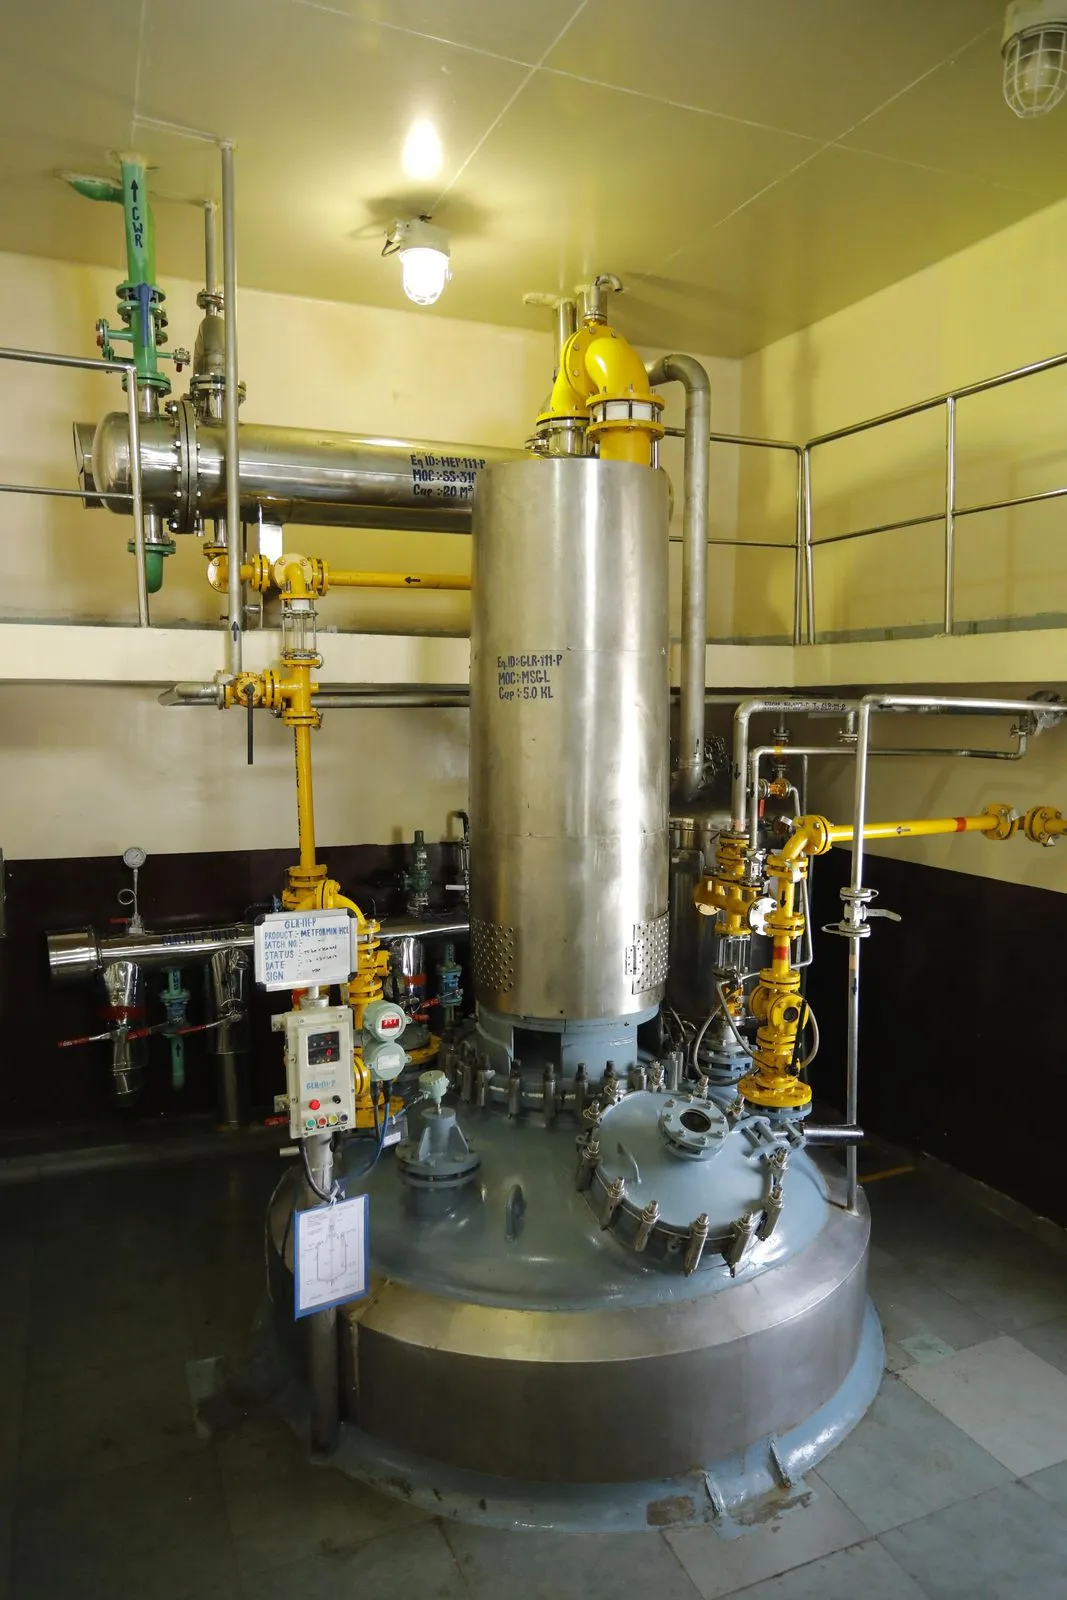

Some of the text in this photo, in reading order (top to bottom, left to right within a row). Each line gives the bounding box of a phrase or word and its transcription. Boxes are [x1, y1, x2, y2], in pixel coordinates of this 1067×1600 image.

[132, 206, 143, 248] CWR
[540, 686, 554, 699] KL
[264, 930, 293, 940] PRODUCT
[300, 927, 337, 938] METFORMIN
[264, 940, 286, 950] BATCH
[265, 950, 295, 960] STATUS
[265, 960, 286, 971] DATE
[266, 971, 284, 981] SIGN
